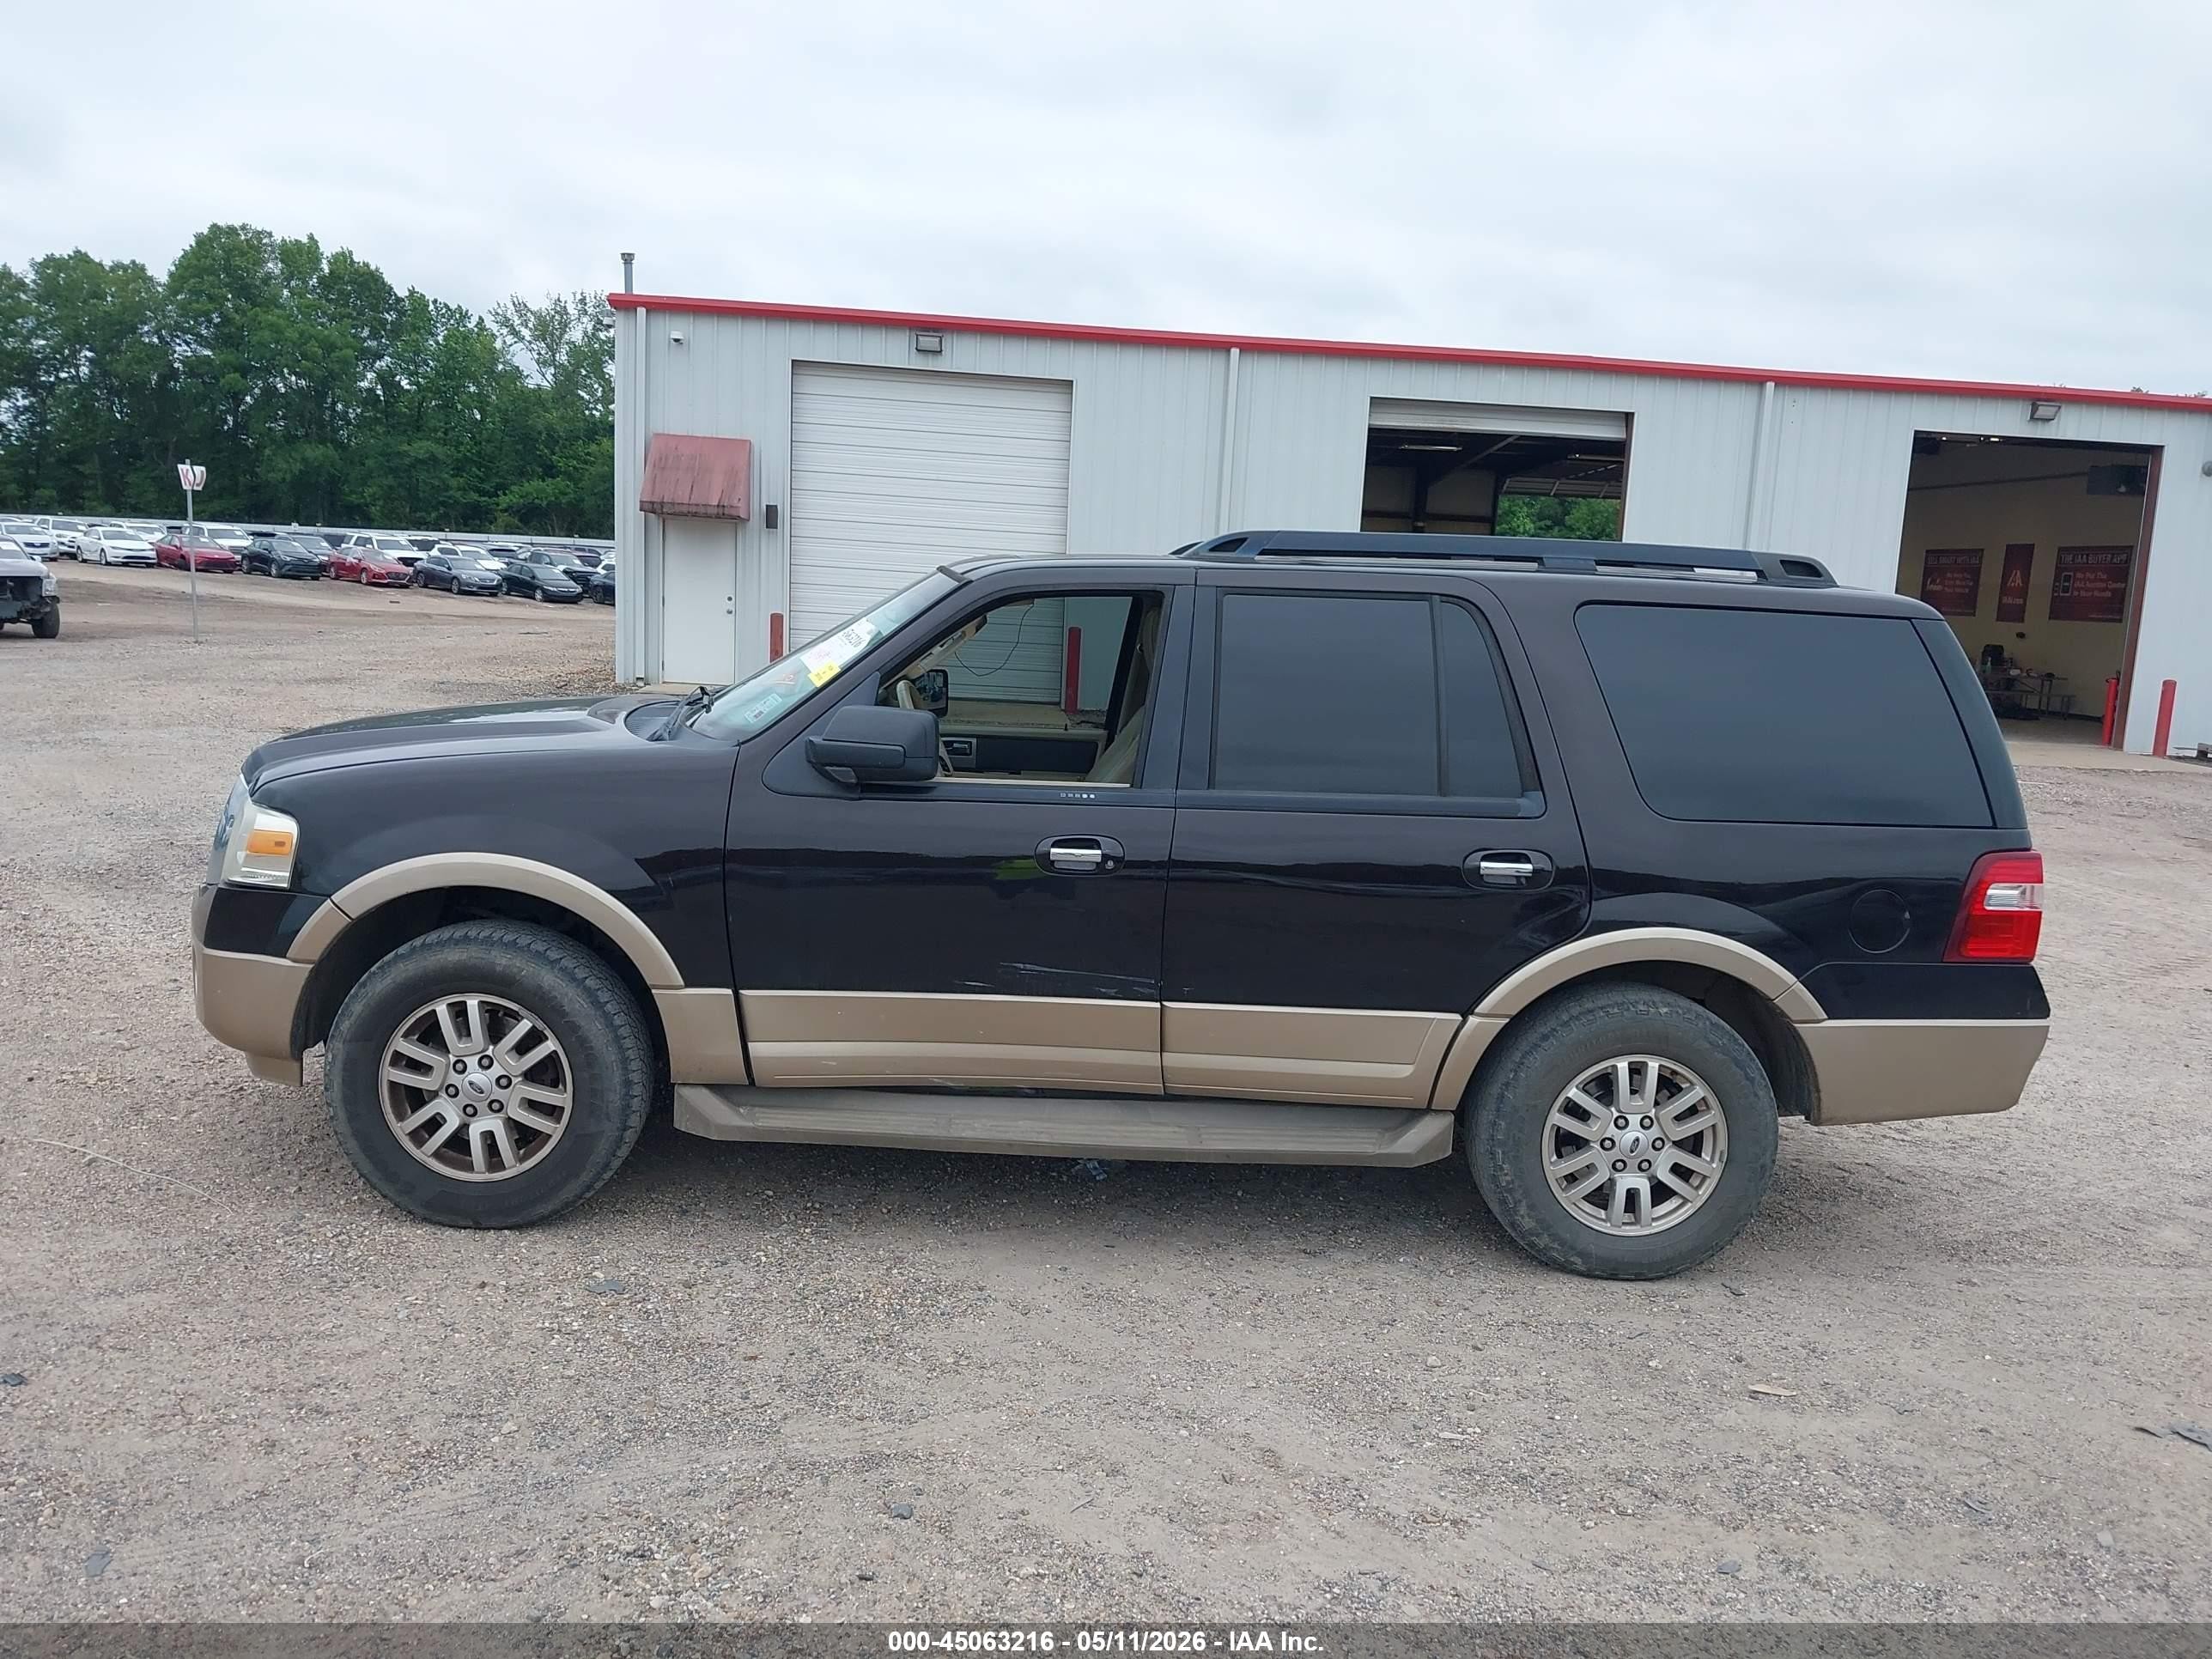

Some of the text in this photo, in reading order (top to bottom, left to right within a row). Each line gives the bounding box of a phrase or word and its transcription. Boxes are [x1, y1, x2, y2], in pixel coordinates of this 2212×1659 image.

[180, 467, 205, 488] K J
[2061, 554, 2073, 564] THE
[2075, 554, 2087, 564] IAA
[2088, 554, 2112, 564] BUYER
